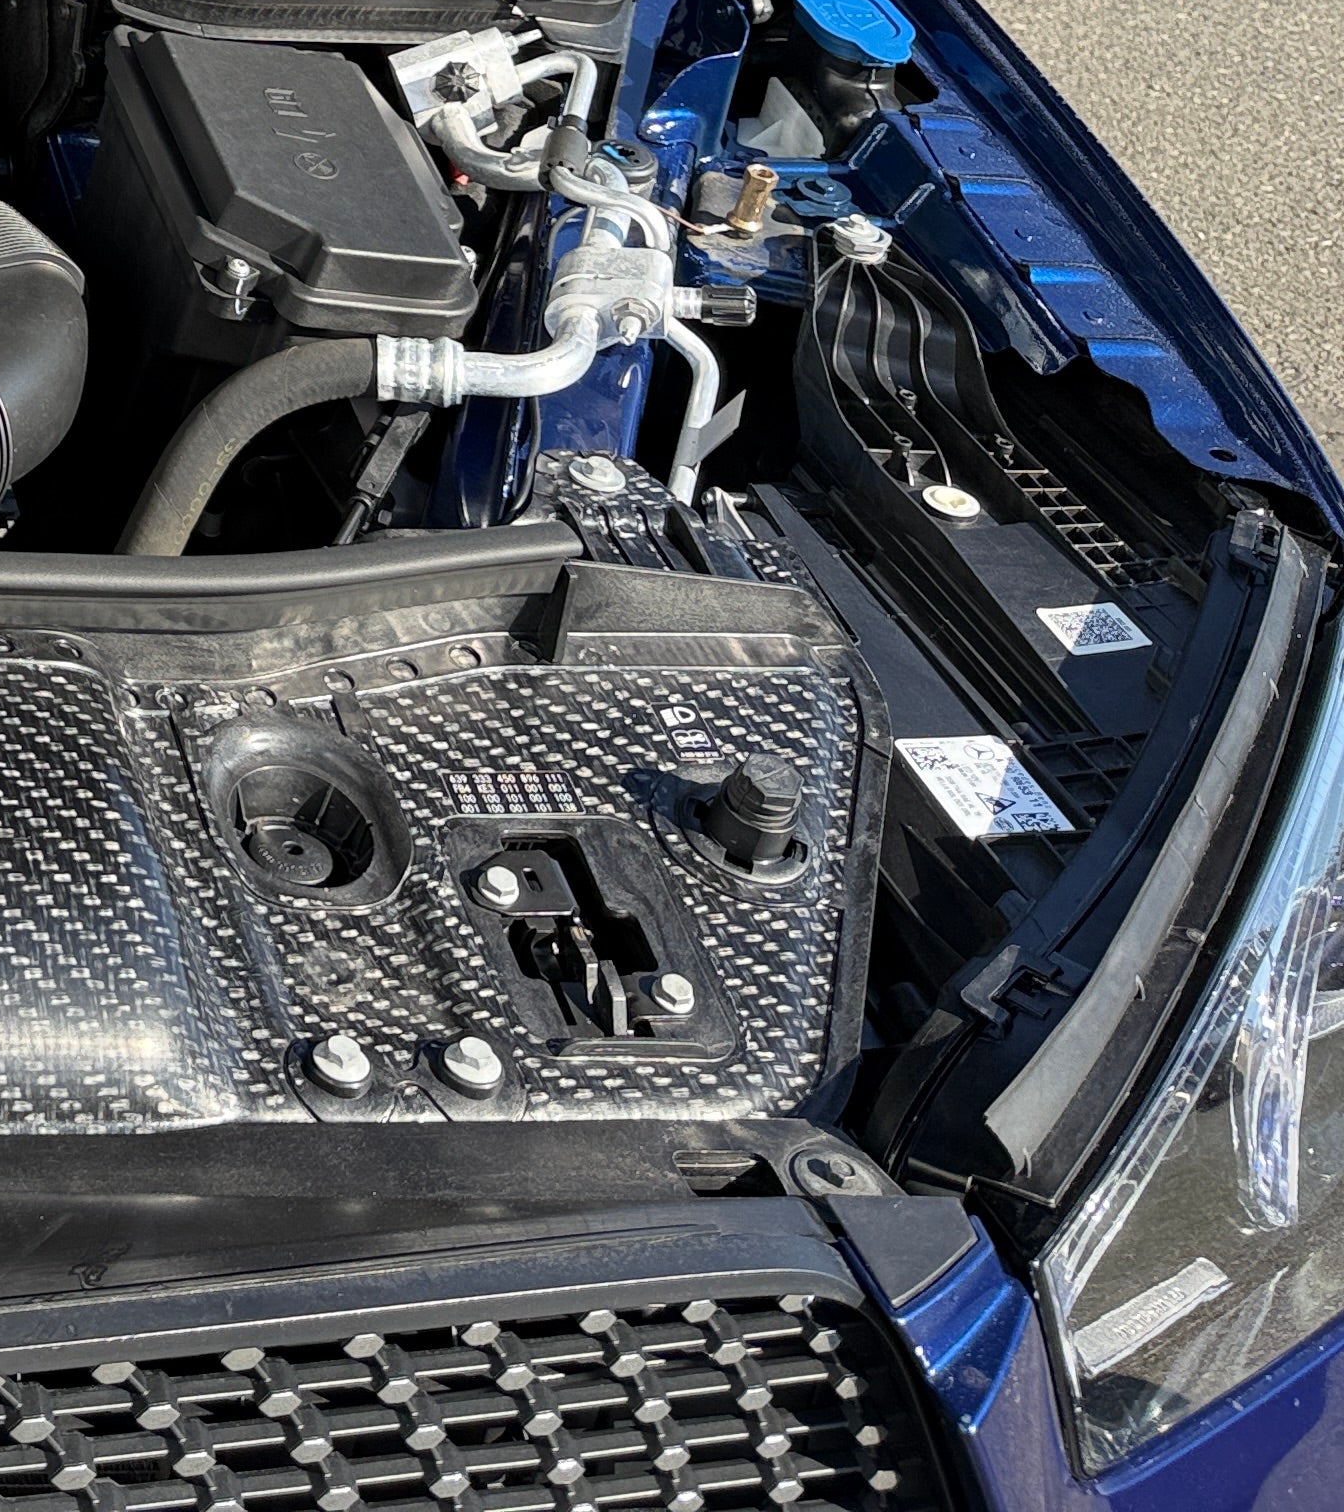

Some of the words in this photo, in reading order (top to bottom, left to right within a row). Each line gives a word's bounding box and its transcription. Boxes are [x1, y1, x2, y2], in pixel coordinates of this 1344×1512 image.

[472, 774, 492, 784] 333
[545, 774, 564, 784] 111
[500, 784, 519, 794] 011
[525, 784, 543, 794] 001
[548, 784, 568, 794] 001
[458, 793, 476, 804] 100
[482, 793, 500, 804] 100
[506, 793, 524, 804] 101
[529, 793, 548, 804] 001
[554, 793, 572, 804] 100
[461, 803, 480, 813] 001
[486, 803, 505, 813] 100
[509, 803, 528, 813] 001
[535, 803, 552, 813] 101
